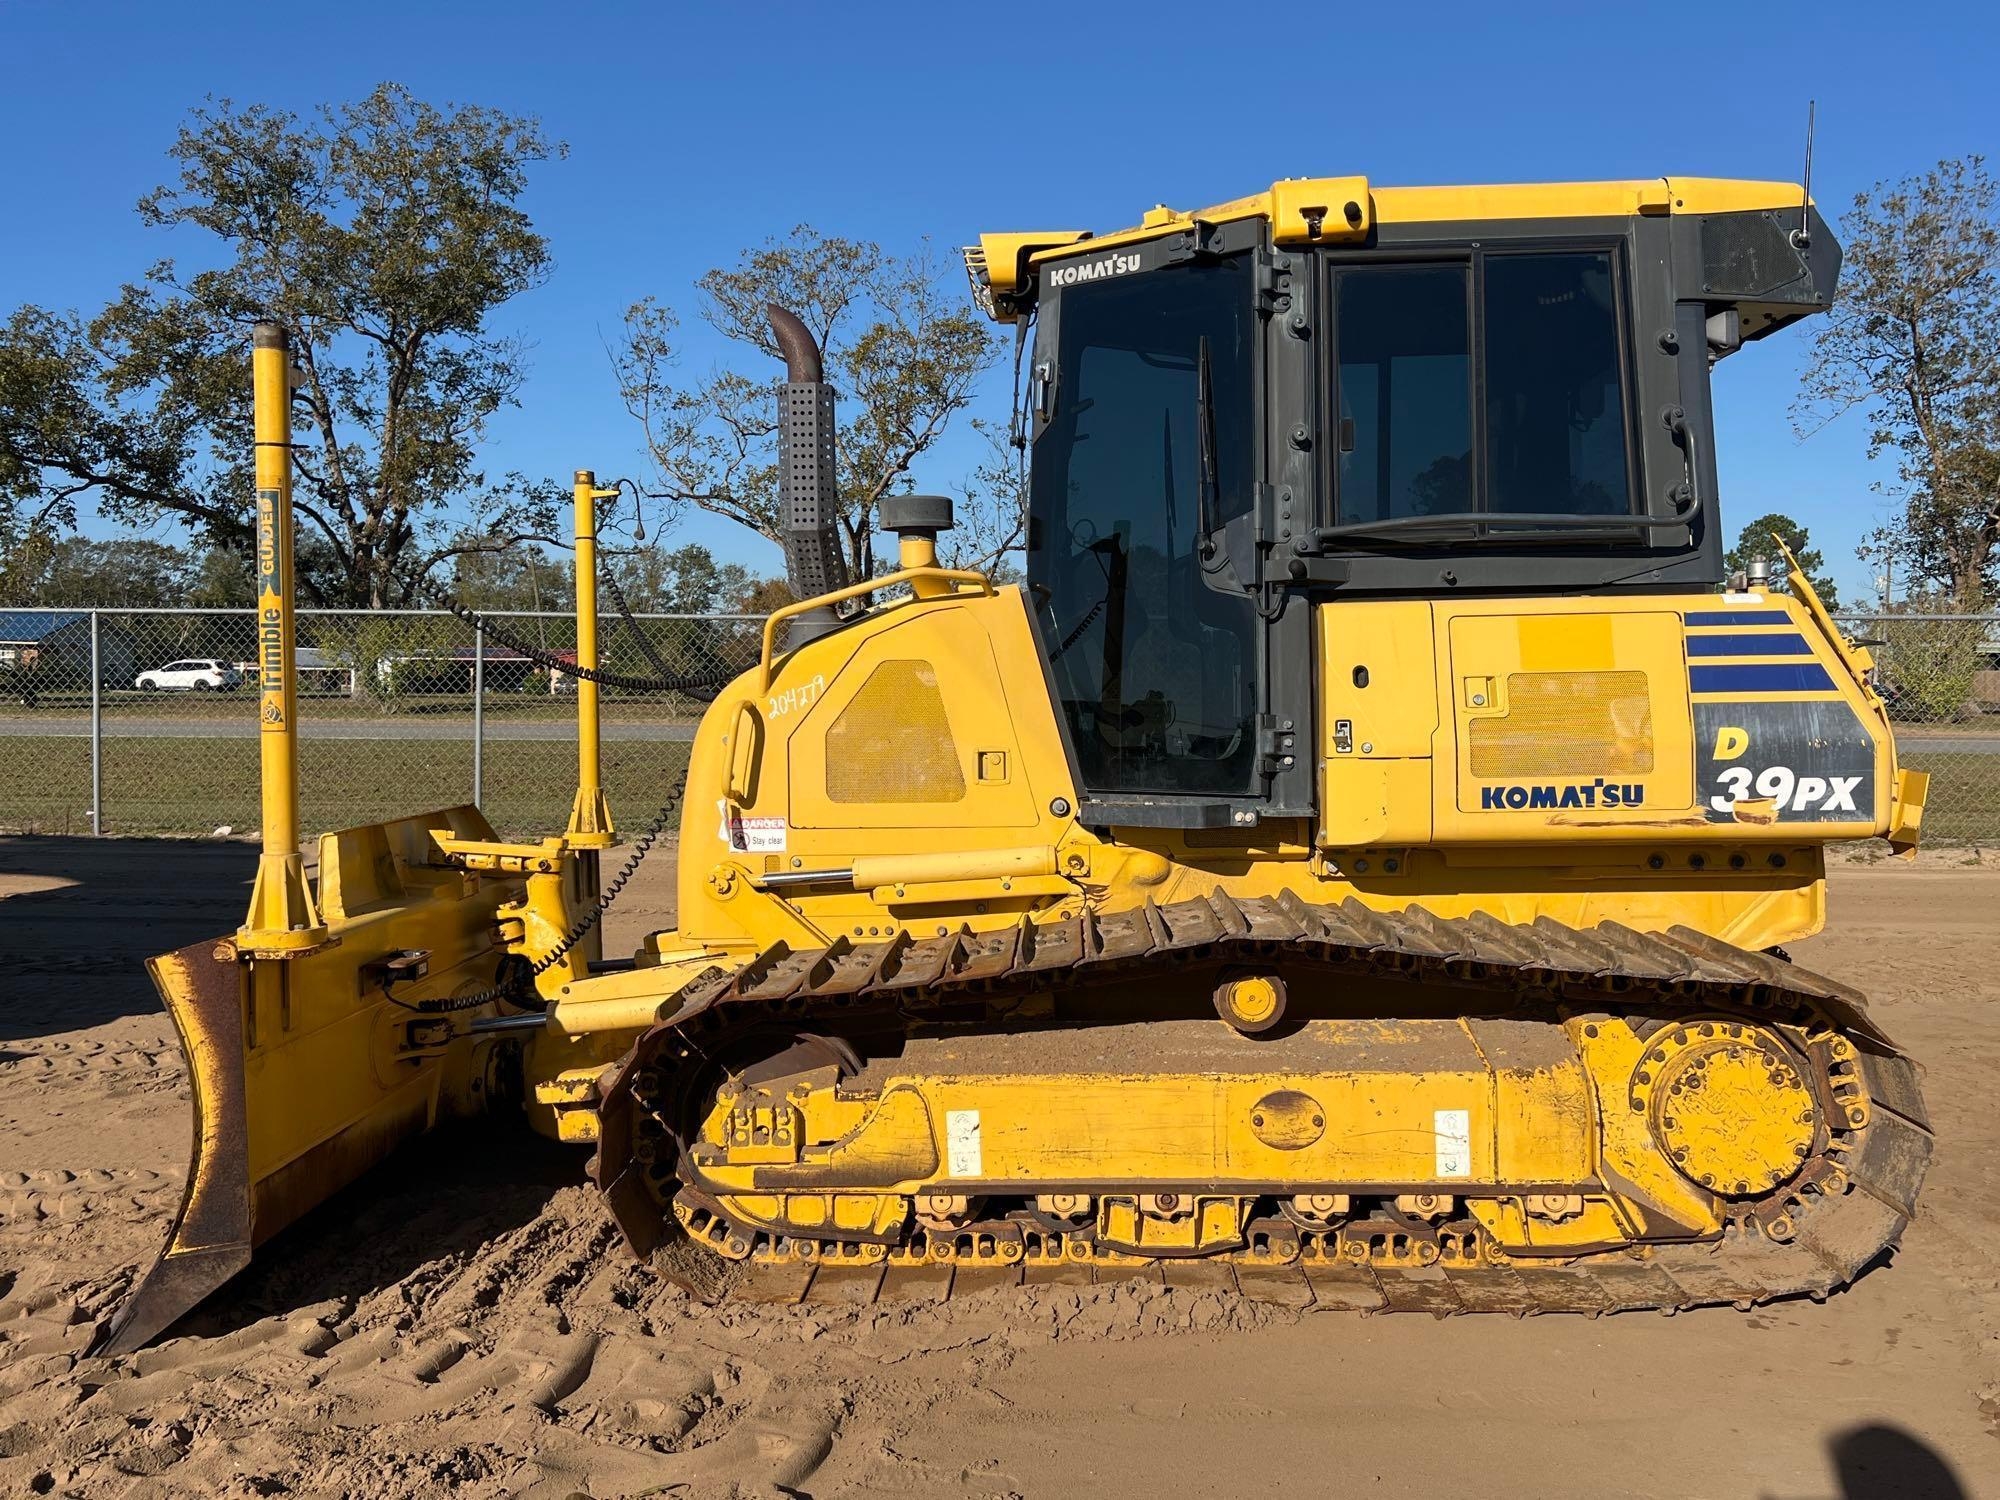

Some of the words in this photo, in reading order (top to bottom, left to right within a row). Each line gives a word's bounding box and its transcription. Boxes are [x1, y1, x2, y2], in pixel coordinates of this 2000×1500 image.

[1050, 253, 1141, 287] KOMATSU
[260, 497, 275, 576] GUIDED
[260, 608, 282, 693] Trimble
[768, 674, 824, 720] 204279
[1712, 726, 1749, 760] D
[1481, 777, 1644, 809] KOMATSU
[1710, 766, 1864, 813] 39PX
[743, 818, 785, 829] DANGER
[752, 836, 765, 846] Stay
[768, 836, 783, 845] clear
